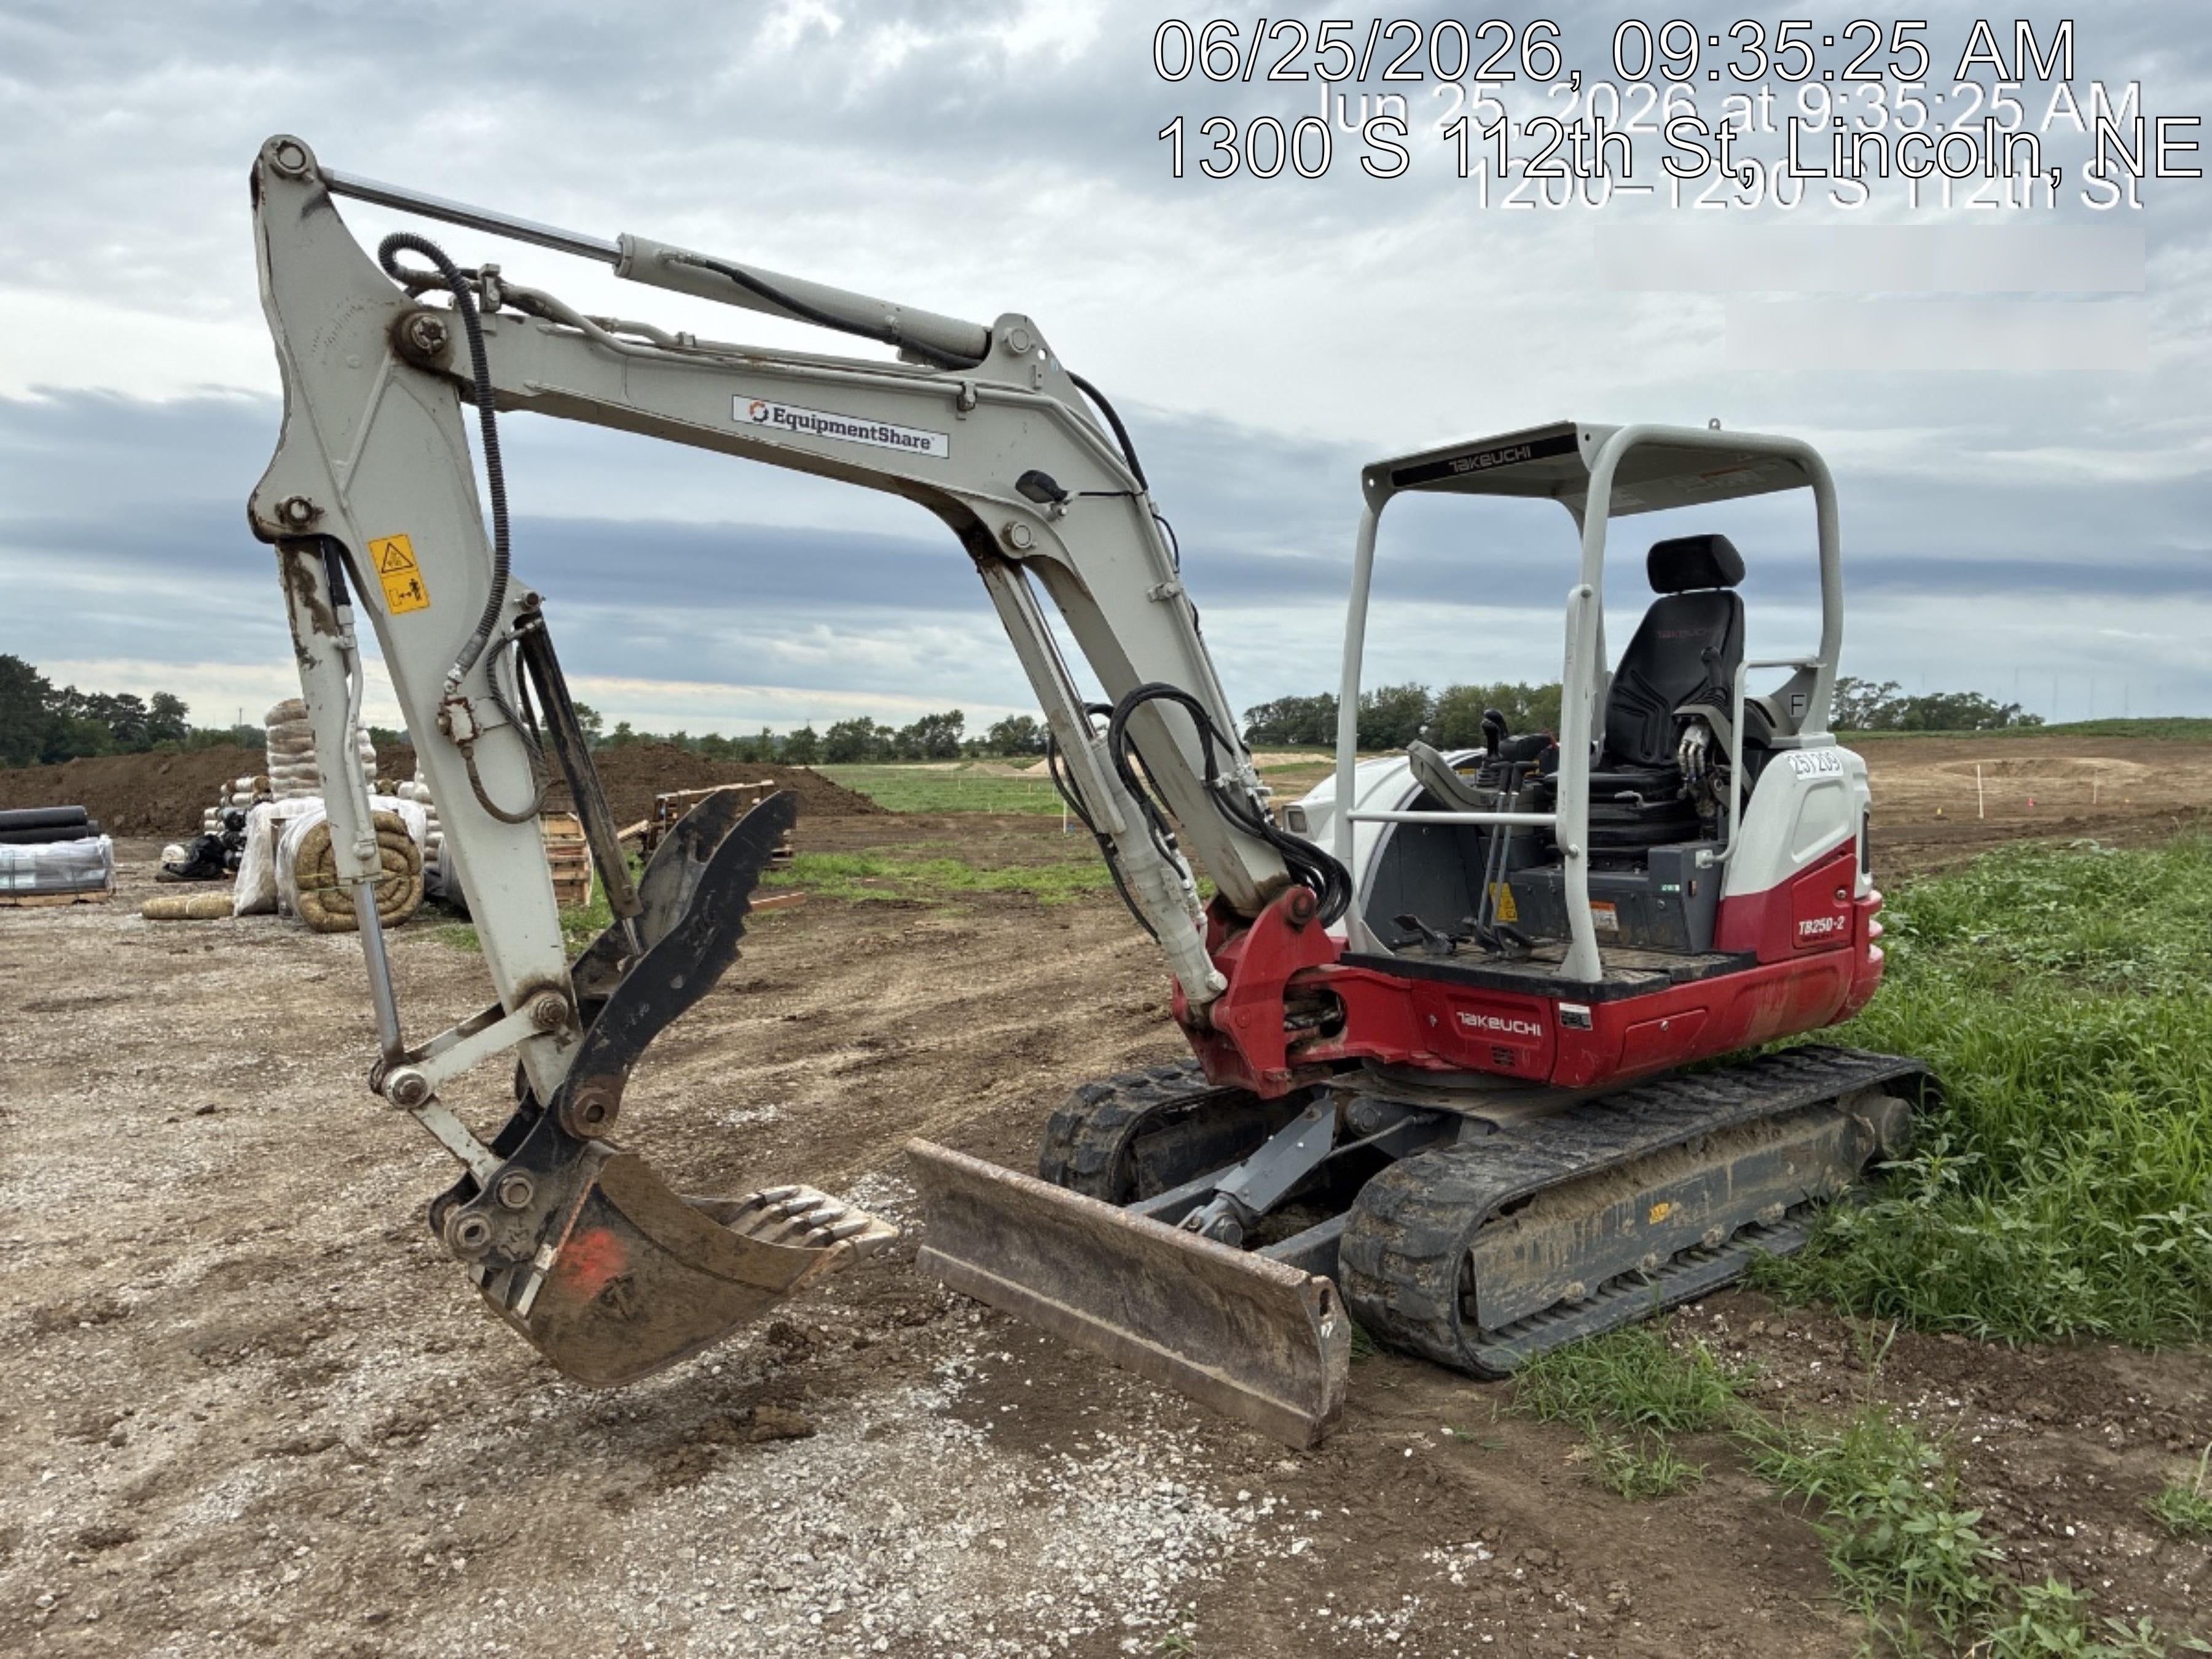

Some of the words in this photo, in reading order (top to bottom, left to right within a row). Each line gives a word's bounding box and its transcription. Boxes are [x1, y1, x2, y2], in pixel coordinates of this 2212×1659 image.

[772, 407, 931, 450] EquipmentShare
[1790, 694, 1806, 716] F
[1798, 915, 1846, 935] TB250-2
